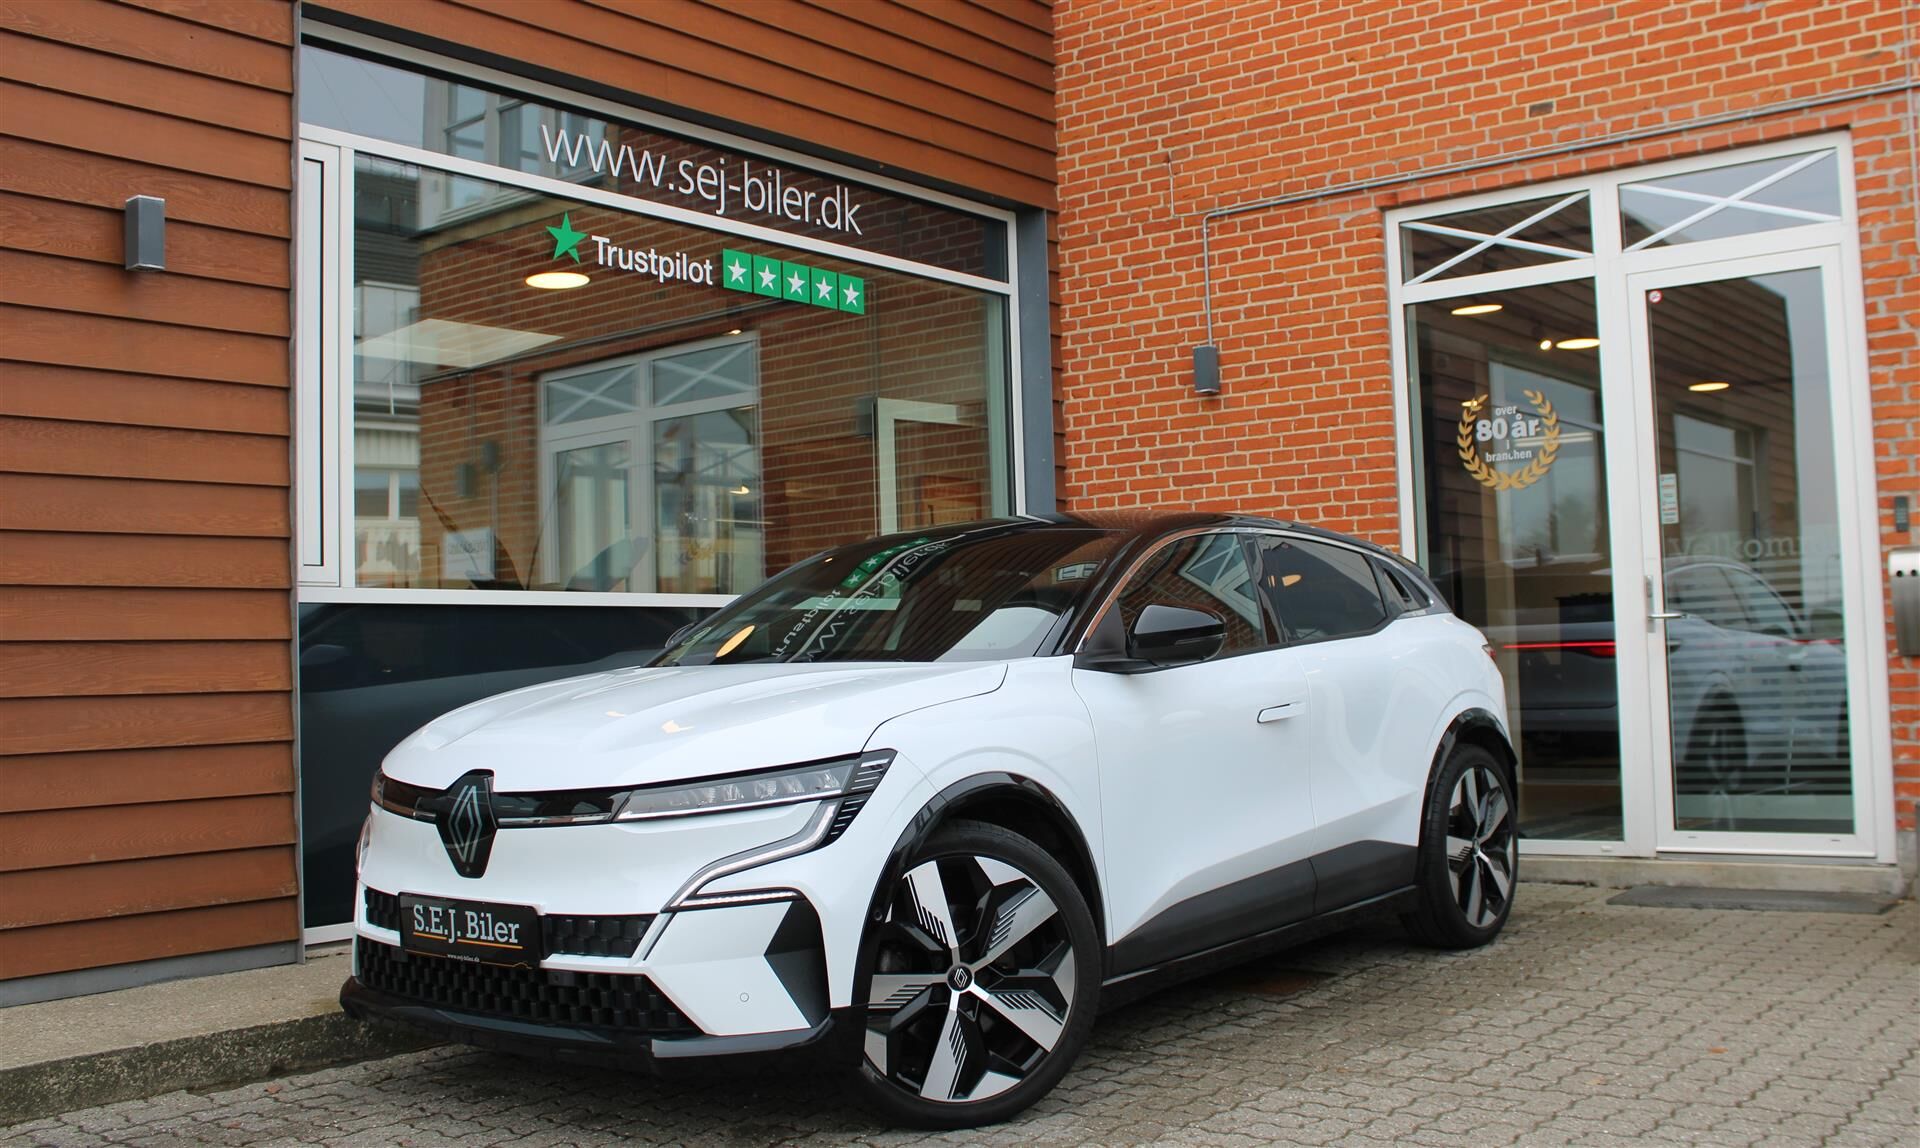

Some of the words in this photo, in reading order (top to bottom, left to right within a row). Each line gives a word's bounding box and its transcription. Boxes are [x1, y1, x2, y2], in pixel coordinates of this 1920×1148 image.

[541, 124, 863, 236] www.sej-biler.dk
[592, 235, 713, 286] Trustpilot
[1476, 418, 1508, 442] 80
[1511, 413, 1539, 438] år
[1495, 405, 1517, 417] over
[1485, 450, 1532, 463] branchen
[413, 904, 461, 943] S.E.J.
[465, 911, 520, 944] Biler
